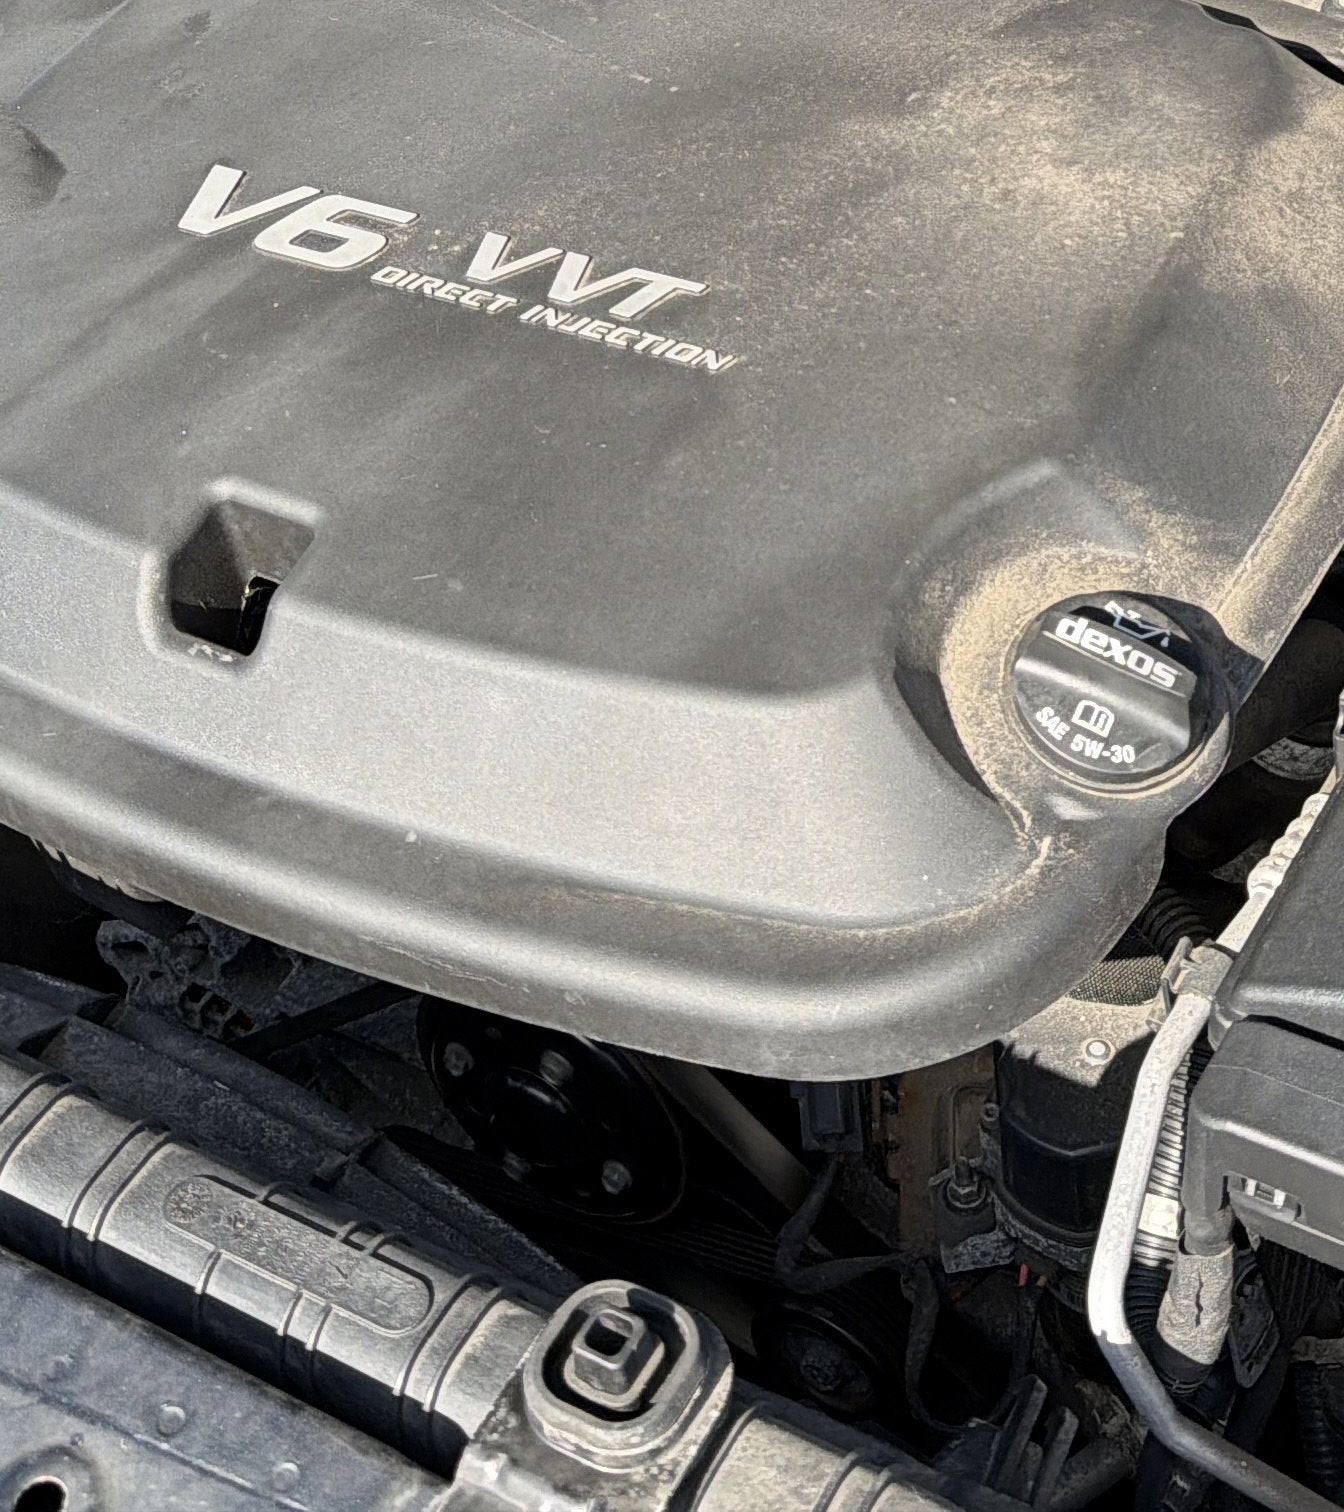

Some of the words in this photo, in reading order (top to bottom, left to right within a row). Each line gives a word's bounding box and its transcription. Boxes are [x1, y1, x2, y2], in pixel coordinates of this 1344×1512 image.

[177, 163, 422, 272] V6
[464, 230, 712, 321] VVT
[370, 264, 520, 315] DIRECT
[519, 303, 744, 374] INJECTION
[1055, 616, 1180, 689] dexos
[1035, 705, 1071, 741] SAE
[1070, 735, 1136, 764] 5W-30
